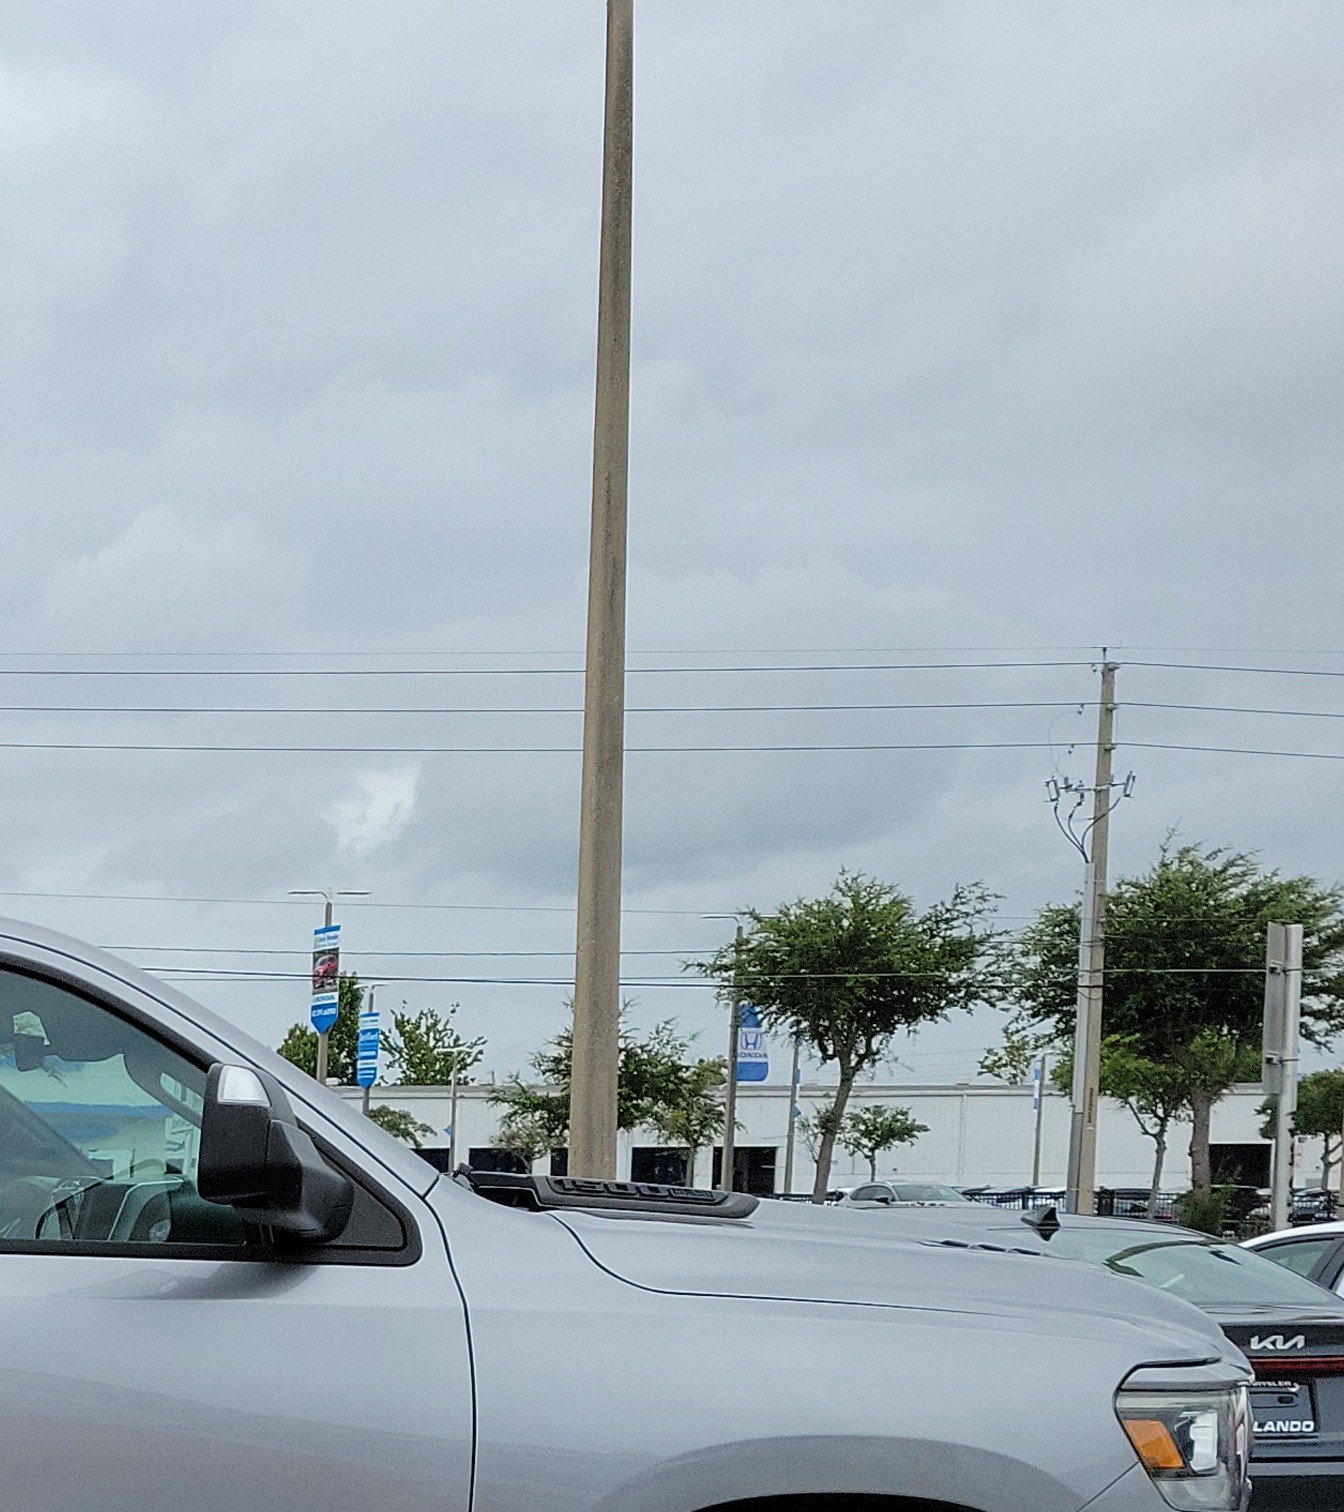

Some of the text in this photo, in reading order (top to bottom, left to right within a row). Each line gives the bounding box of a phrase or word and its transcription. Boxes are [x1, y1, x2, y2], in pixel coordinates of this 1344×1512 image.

[737, 1051, 768, 1059] ONDA
[1250, 1334, 1306, 1350] KIA
[1252, 1420, 1316, 1433] LANDO
